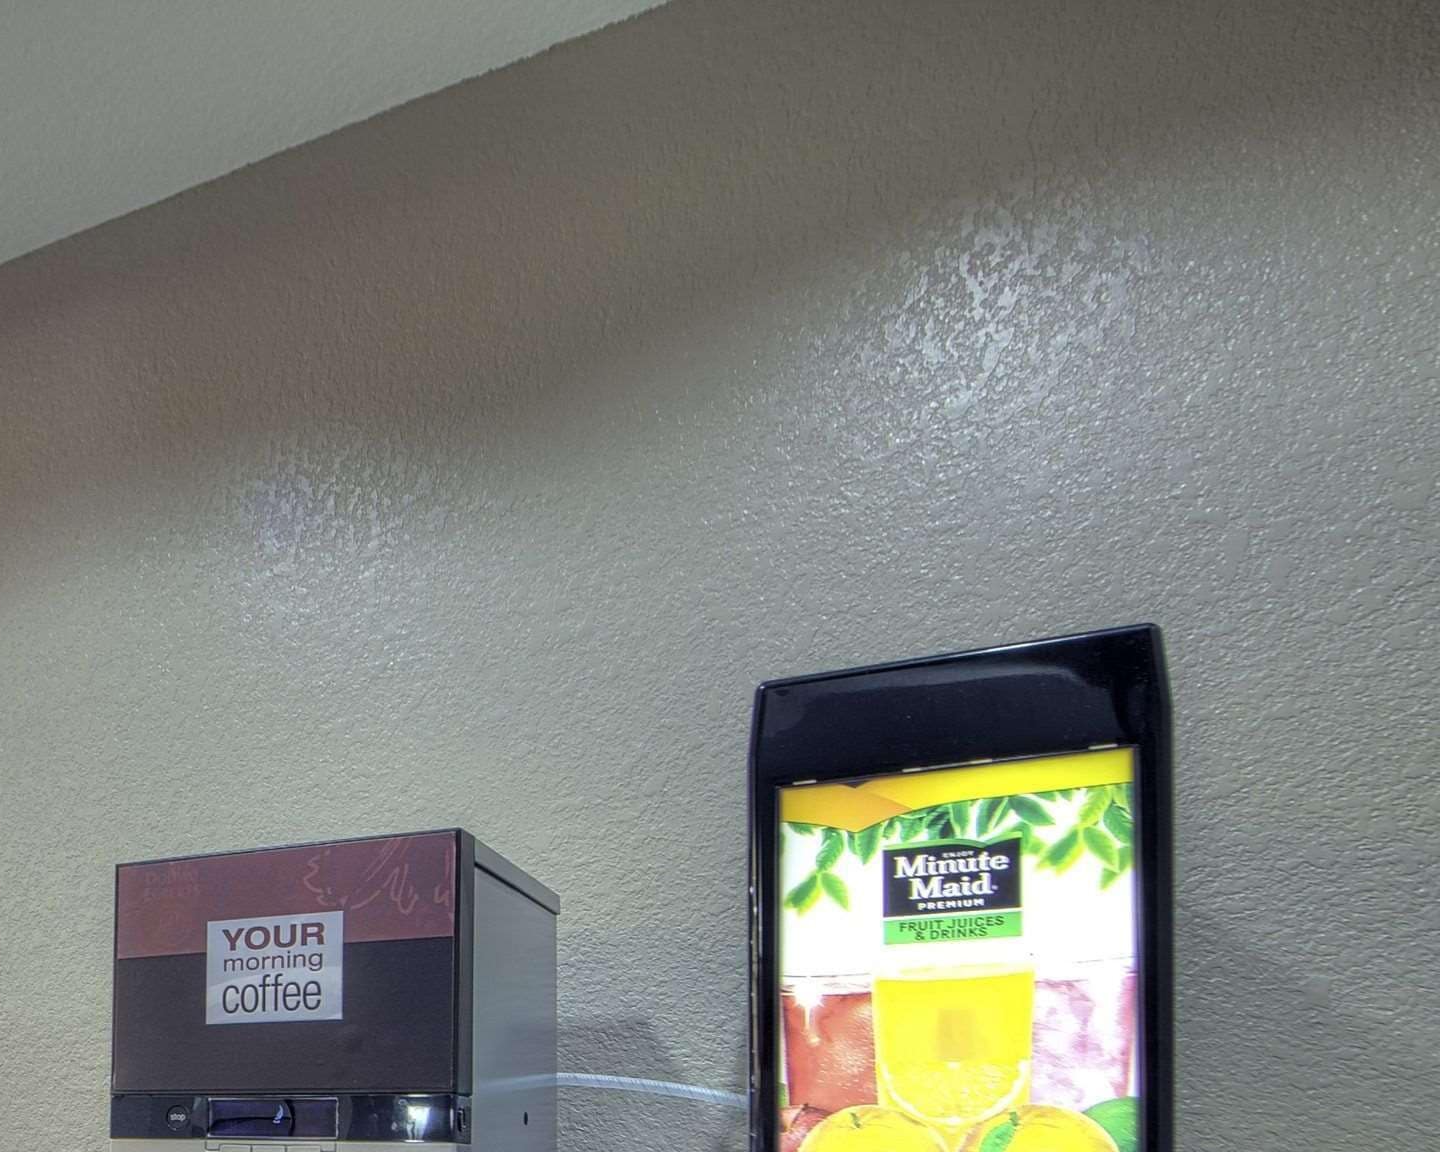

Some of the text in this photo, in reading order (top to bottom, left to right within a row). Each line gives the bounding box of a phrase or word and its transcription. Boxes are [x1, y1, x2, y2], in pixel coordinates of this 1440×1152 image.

[894, 852, 1010, 878] Minute
[942, 850, 975, 859] ENJOY
[908, 872, 995, 900] Maid
[917, 898, 985, 910] PREMIUM
[899, 915, 1005, 933] FRUIT JUICES
[914, 926, 988, 941] & DRINKS
[221, 922, 325, 951] YOUR
[223, 950, 323, 972] morning
[222, 973, 321, 1014] coffee
